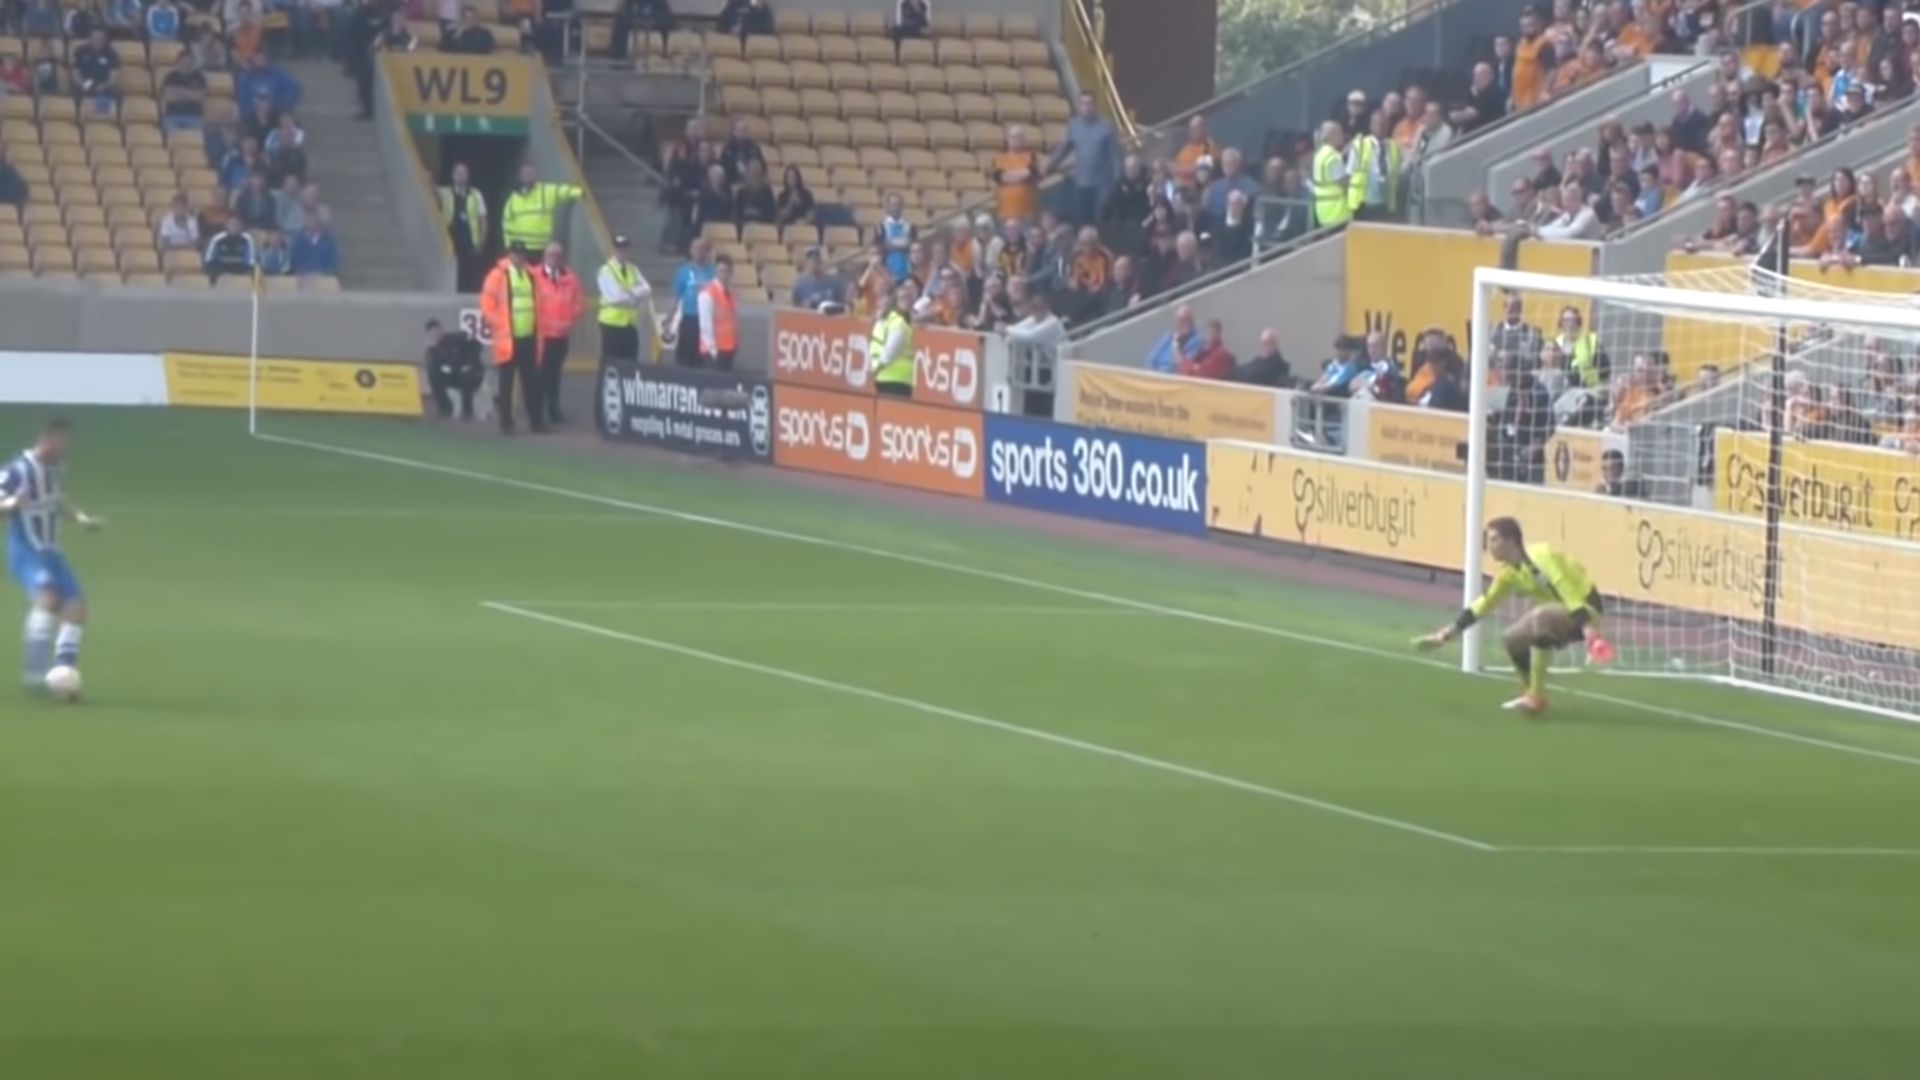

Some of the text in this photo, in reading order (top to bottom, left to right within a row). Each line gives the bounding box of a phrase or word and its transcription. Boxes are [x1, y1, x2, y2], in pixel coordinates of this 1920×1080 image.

[413, 65, 508, 105] WL9
[991, 436, 1199, 512] sports 360.co.uk
[1752, 464, 1874, 529] sverbug.it
[1316, 475, 1417, 548] silverbug.it
[1663, 528, 1785, 608] silverbugt
